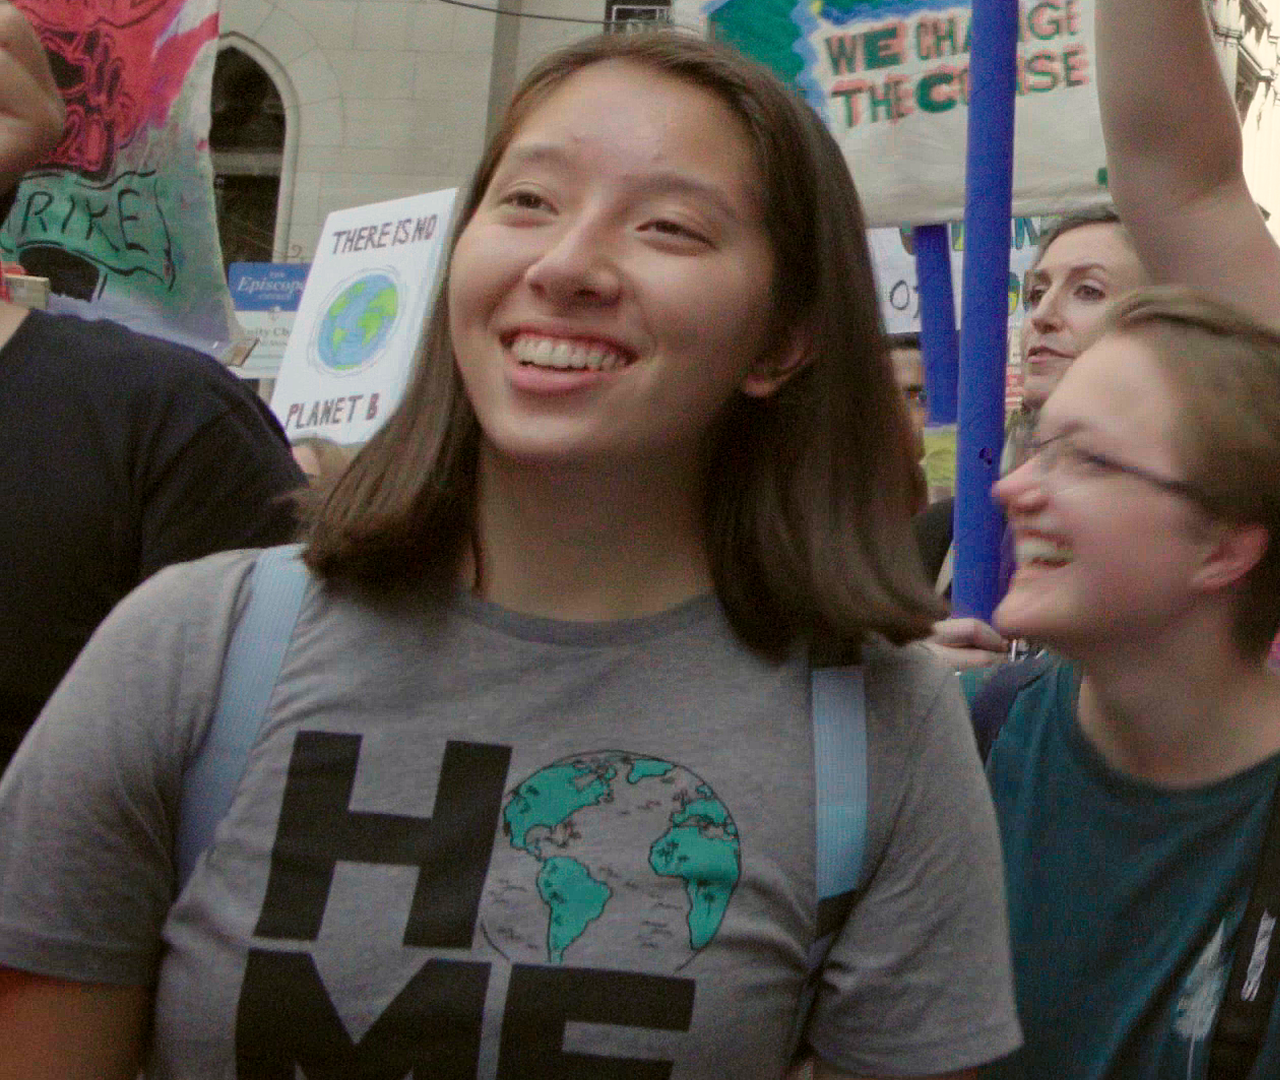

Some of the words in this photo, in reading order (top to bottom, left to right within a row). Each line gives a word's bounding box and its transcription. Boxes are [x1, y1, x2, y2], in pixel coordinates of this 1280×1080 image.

[826, 22, 906, 76] WE
[831, 75, 913, 129] THE
[21, 187, 150, 254] RIKE
[331, 222, 391, 255] THERE
[392, 218, 410, 246] IS
[411, 214, 438, 241] NO
[237, 275, 305, 295] Episcop
[285, 395, 364, 432] PLANET
[366, 392, 381, 421] B
